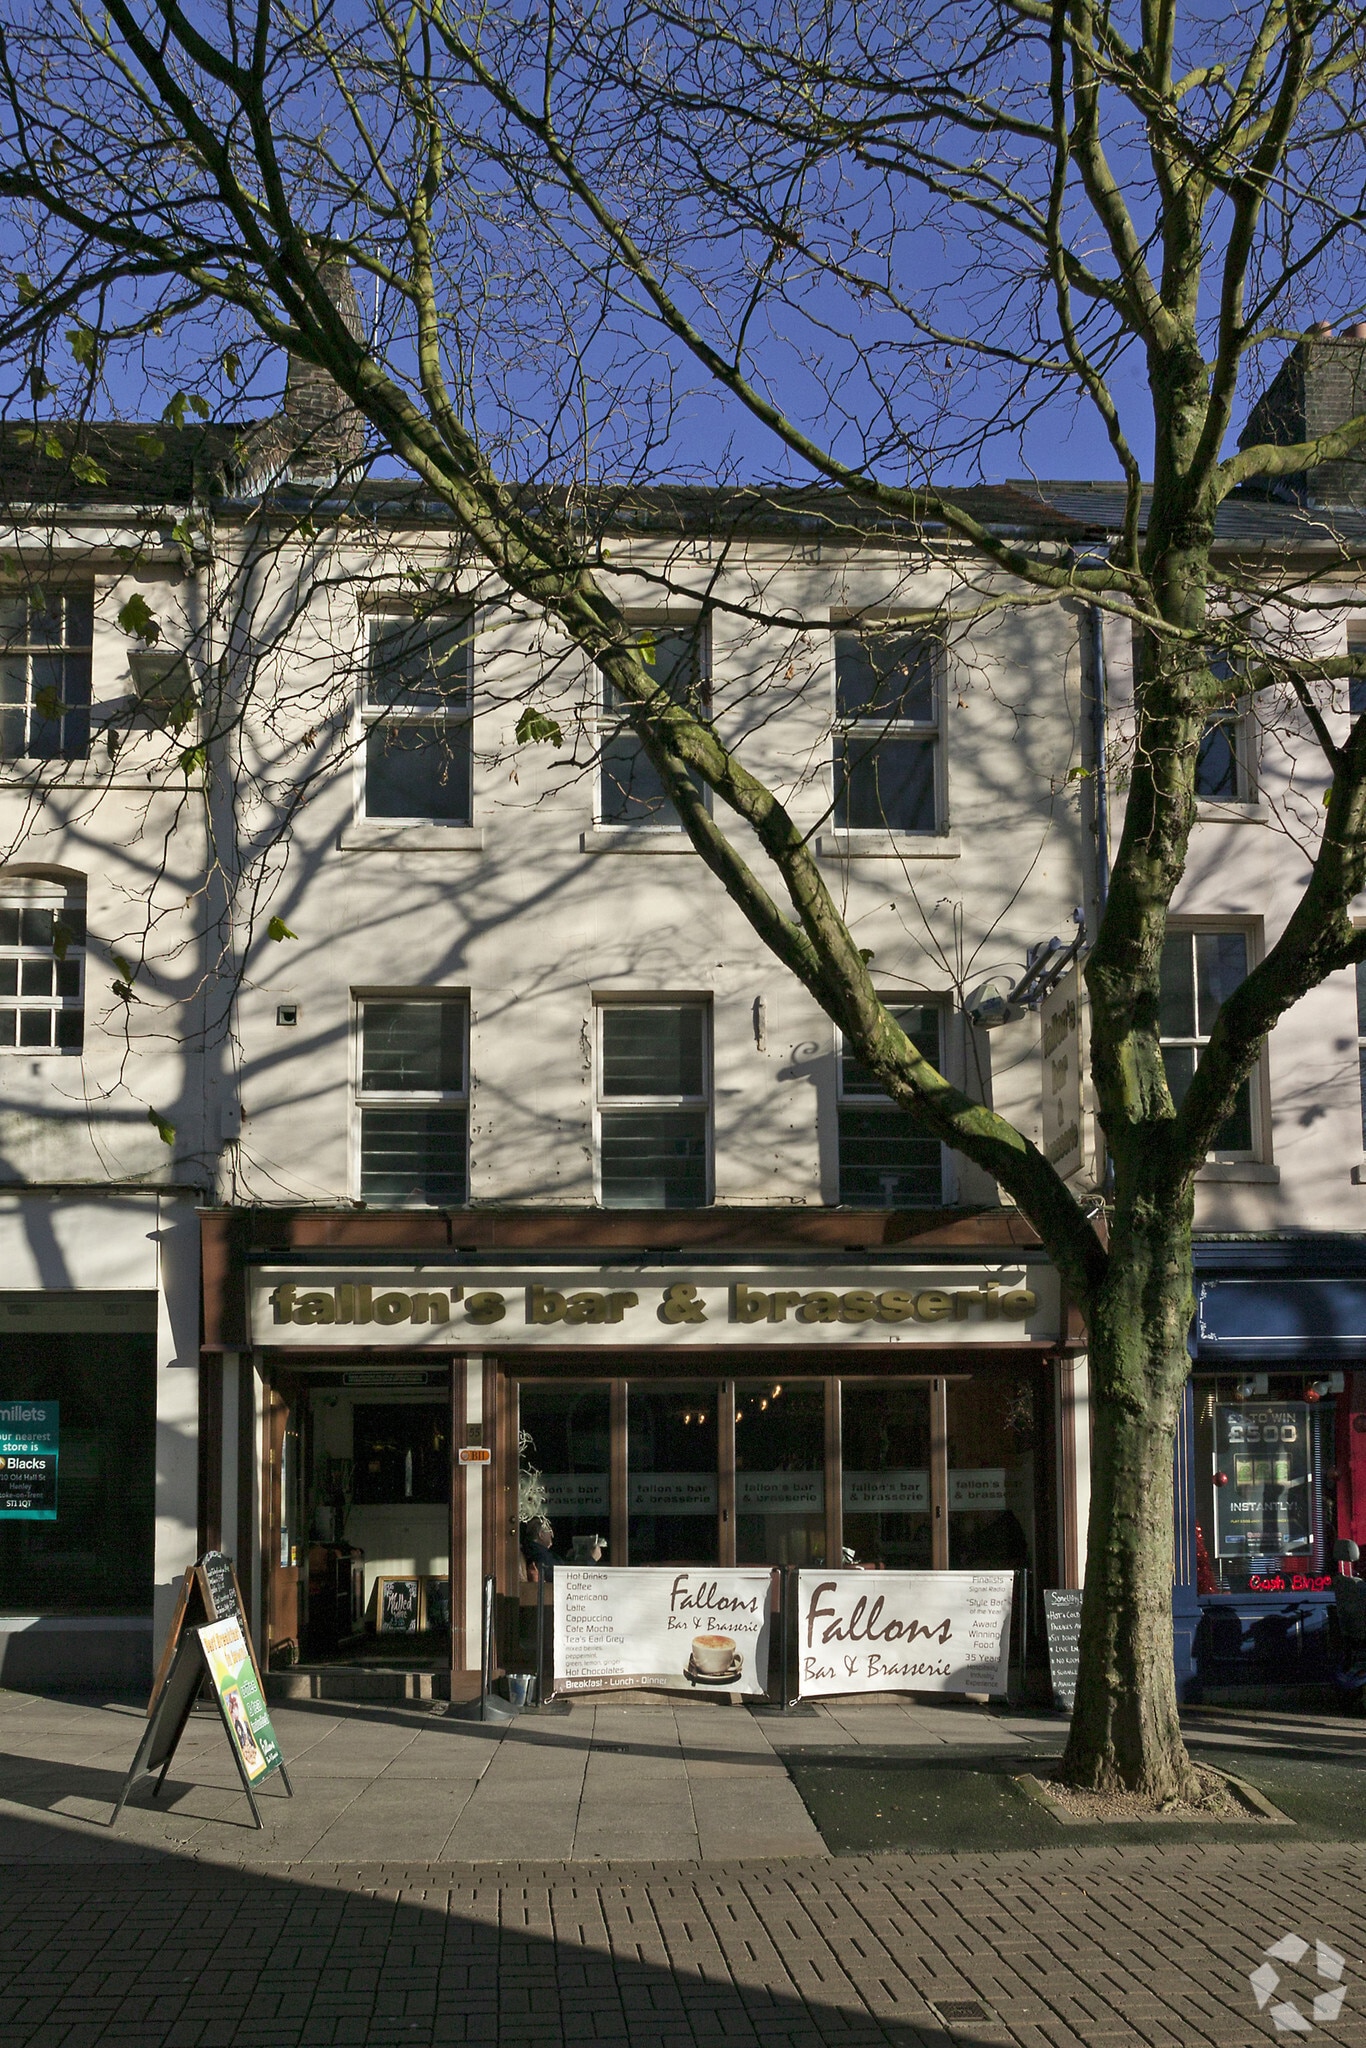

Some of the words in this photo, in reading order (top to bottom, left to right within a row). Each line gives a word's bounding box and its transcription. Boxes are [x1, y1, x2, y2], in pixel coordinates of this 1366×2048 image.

[269, 1283, 507, 1326] fallon's
[525, 1283, 639, 1325] bar
[657, 1283, 709, 1325] &
[728, 1281, 1041, 1324] brasserie
[1249, 1413, 1268, 1424] TO
[1271, 1412, 1297, 1423] WIN
[15, 1432, 51, 1441] nearest
[468, 1427, 481, 1438] 55
[1228, 1424, 1298, 1443] £500
[2, 1443, 28, 1451] store
[31, 1442, 39, 1451] is
[7, 1457, 46, 1469] Blacks
[578, 1485, 599, 1494] bar
[637, 1484, 683, 1494] fallon's
[687, 1484, 708, 1494] bar
[744, 1483, 789, 1492] fallon's
[793, 1482, 814, 1492] bar
[851, 1482, 896, 1491] fallon's
[900, 1482, 921, 1491] bar
[649, 1494, 711, 1504] brasserie
[756, 1492, 817, 1502] brasserie
[863, 1491, 924, 1501] brasserie
[1230, 1501, 1298, 1512] INSTANTLY!
[566, 1572, 580, 1580] Hot
[582, 1572, 608, 1580] Drinks
[972, 1576, 1004, 1584] Finalists
[566, 1582, 592, 1591] Coffee
[1249, 1575, 1285, 1592] Cash
[1291, 1575, 1332, 1592] Bingo
[566, 1593, 609, 1601] Americano
[670, 1573, 759, 1613] Fallons
[566, 1603, 586, 1612] Latte
[566, 1614, 613, 1624] Cappuccino
[805, 1581, 953, 1648] Fallons
[1050, 1610, 1062, 1620] HOT
[667, 1615, 688, 1630] Bar
[692, 1616, 702, 1630] &
[707, 1616, 758, 1632] Brasserie
[972, 1620, 997, 1628] Award
[565, 1625, 584, 1633] Cafe
[586, 1625, 614, 1633] Mocha
[566, 1635, 586, 1643] Tea's
[588, 1635, 604, 1643] Earl
[605, 1635, 625, 1644] Grey
[968, 1630, 1001, 1640] Winning
[973, 1640, 994, 1649] Food
[965, 1653, 977, 1662] 35
[979, 1653, 1002, 1663] Years
[566, 1668, 580, 1676] Hot
[581, 1666, 625, 1676] Chocolates
[804, 1656, 836, 1682] Bar
[843, 1654, 859, 1678] &
[867, 1653, 951, 1679] Brasserie
[565, 1678, 603, 1689] Breakfast
[610, 1677, 634, 1686] Lunch
[641, 1676, 667, 1685] Dinner
